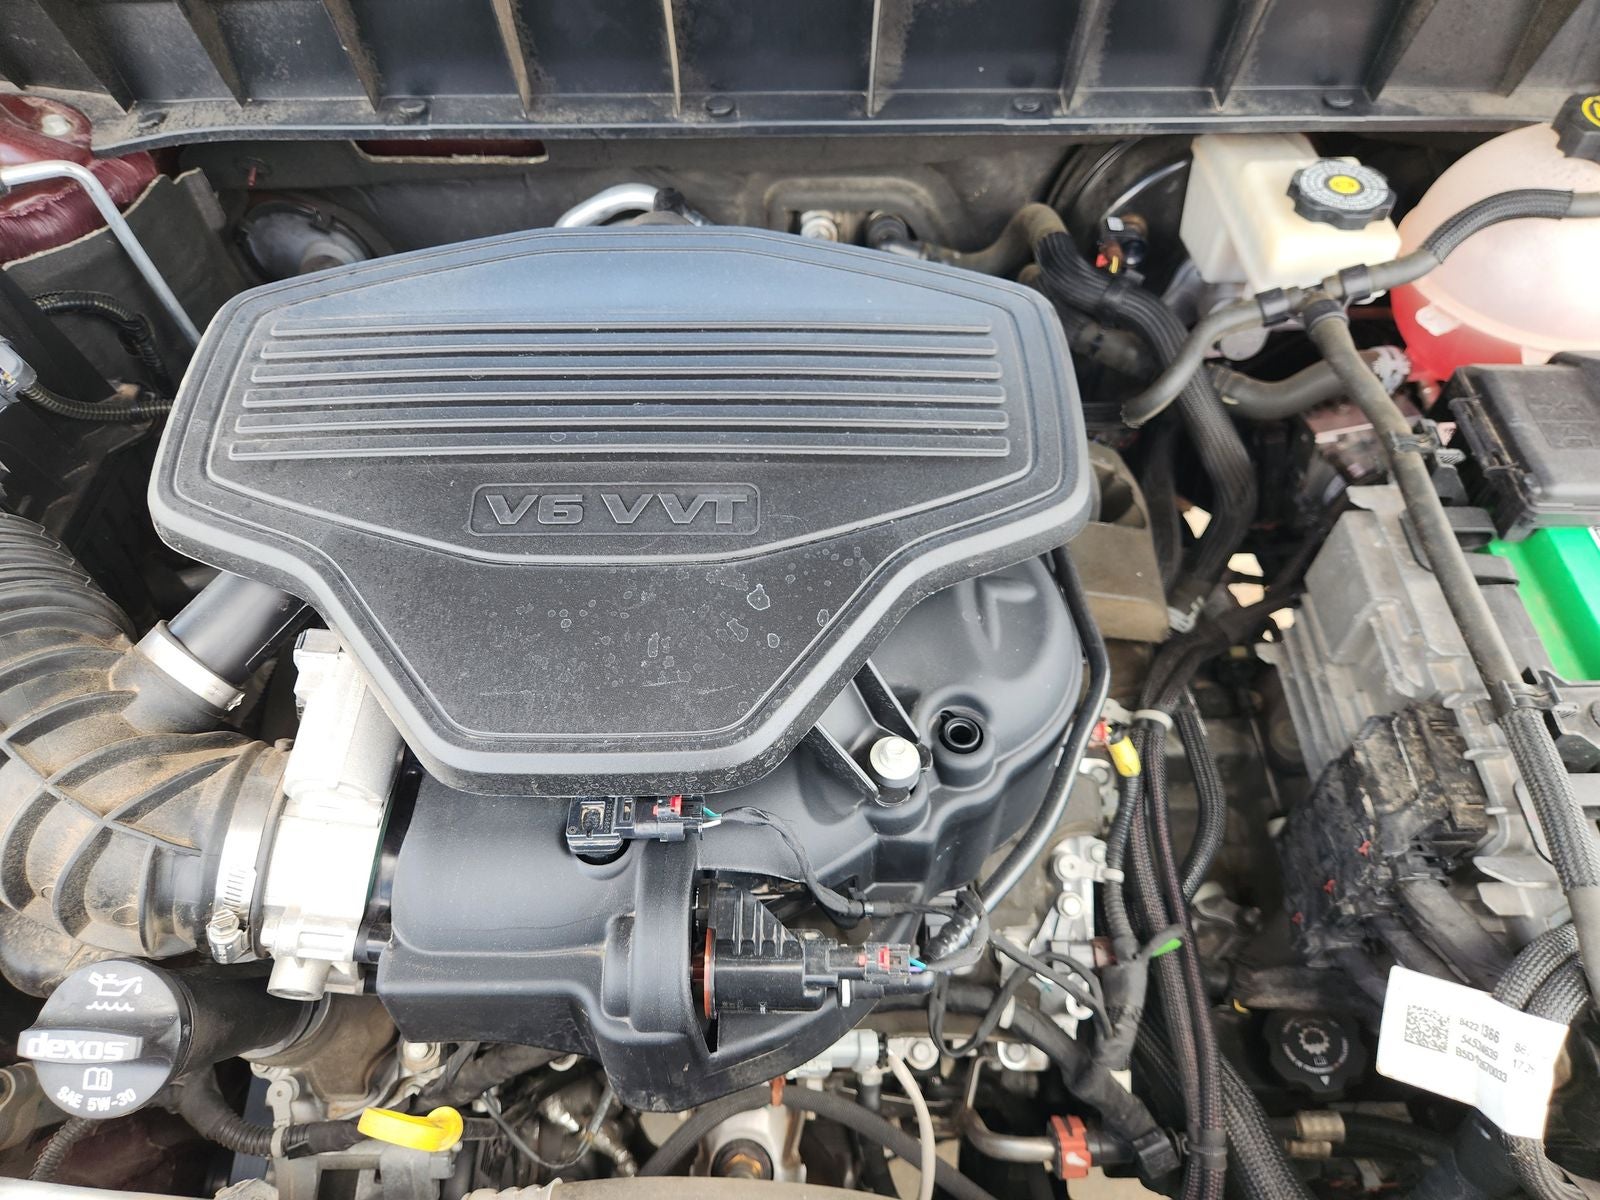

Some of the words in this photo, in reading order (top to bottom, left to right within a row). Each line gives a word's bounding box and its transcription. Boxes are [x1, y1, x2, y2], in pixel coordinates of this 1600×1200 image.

[485, 494, 584, 525] V6
[600, 493, 748, 524] VVT
[26, 1032, 128, 1060] dexos
[57, 1086, 84, 1109] SAE
[87, 1088, 137, 1112] 5W-30
